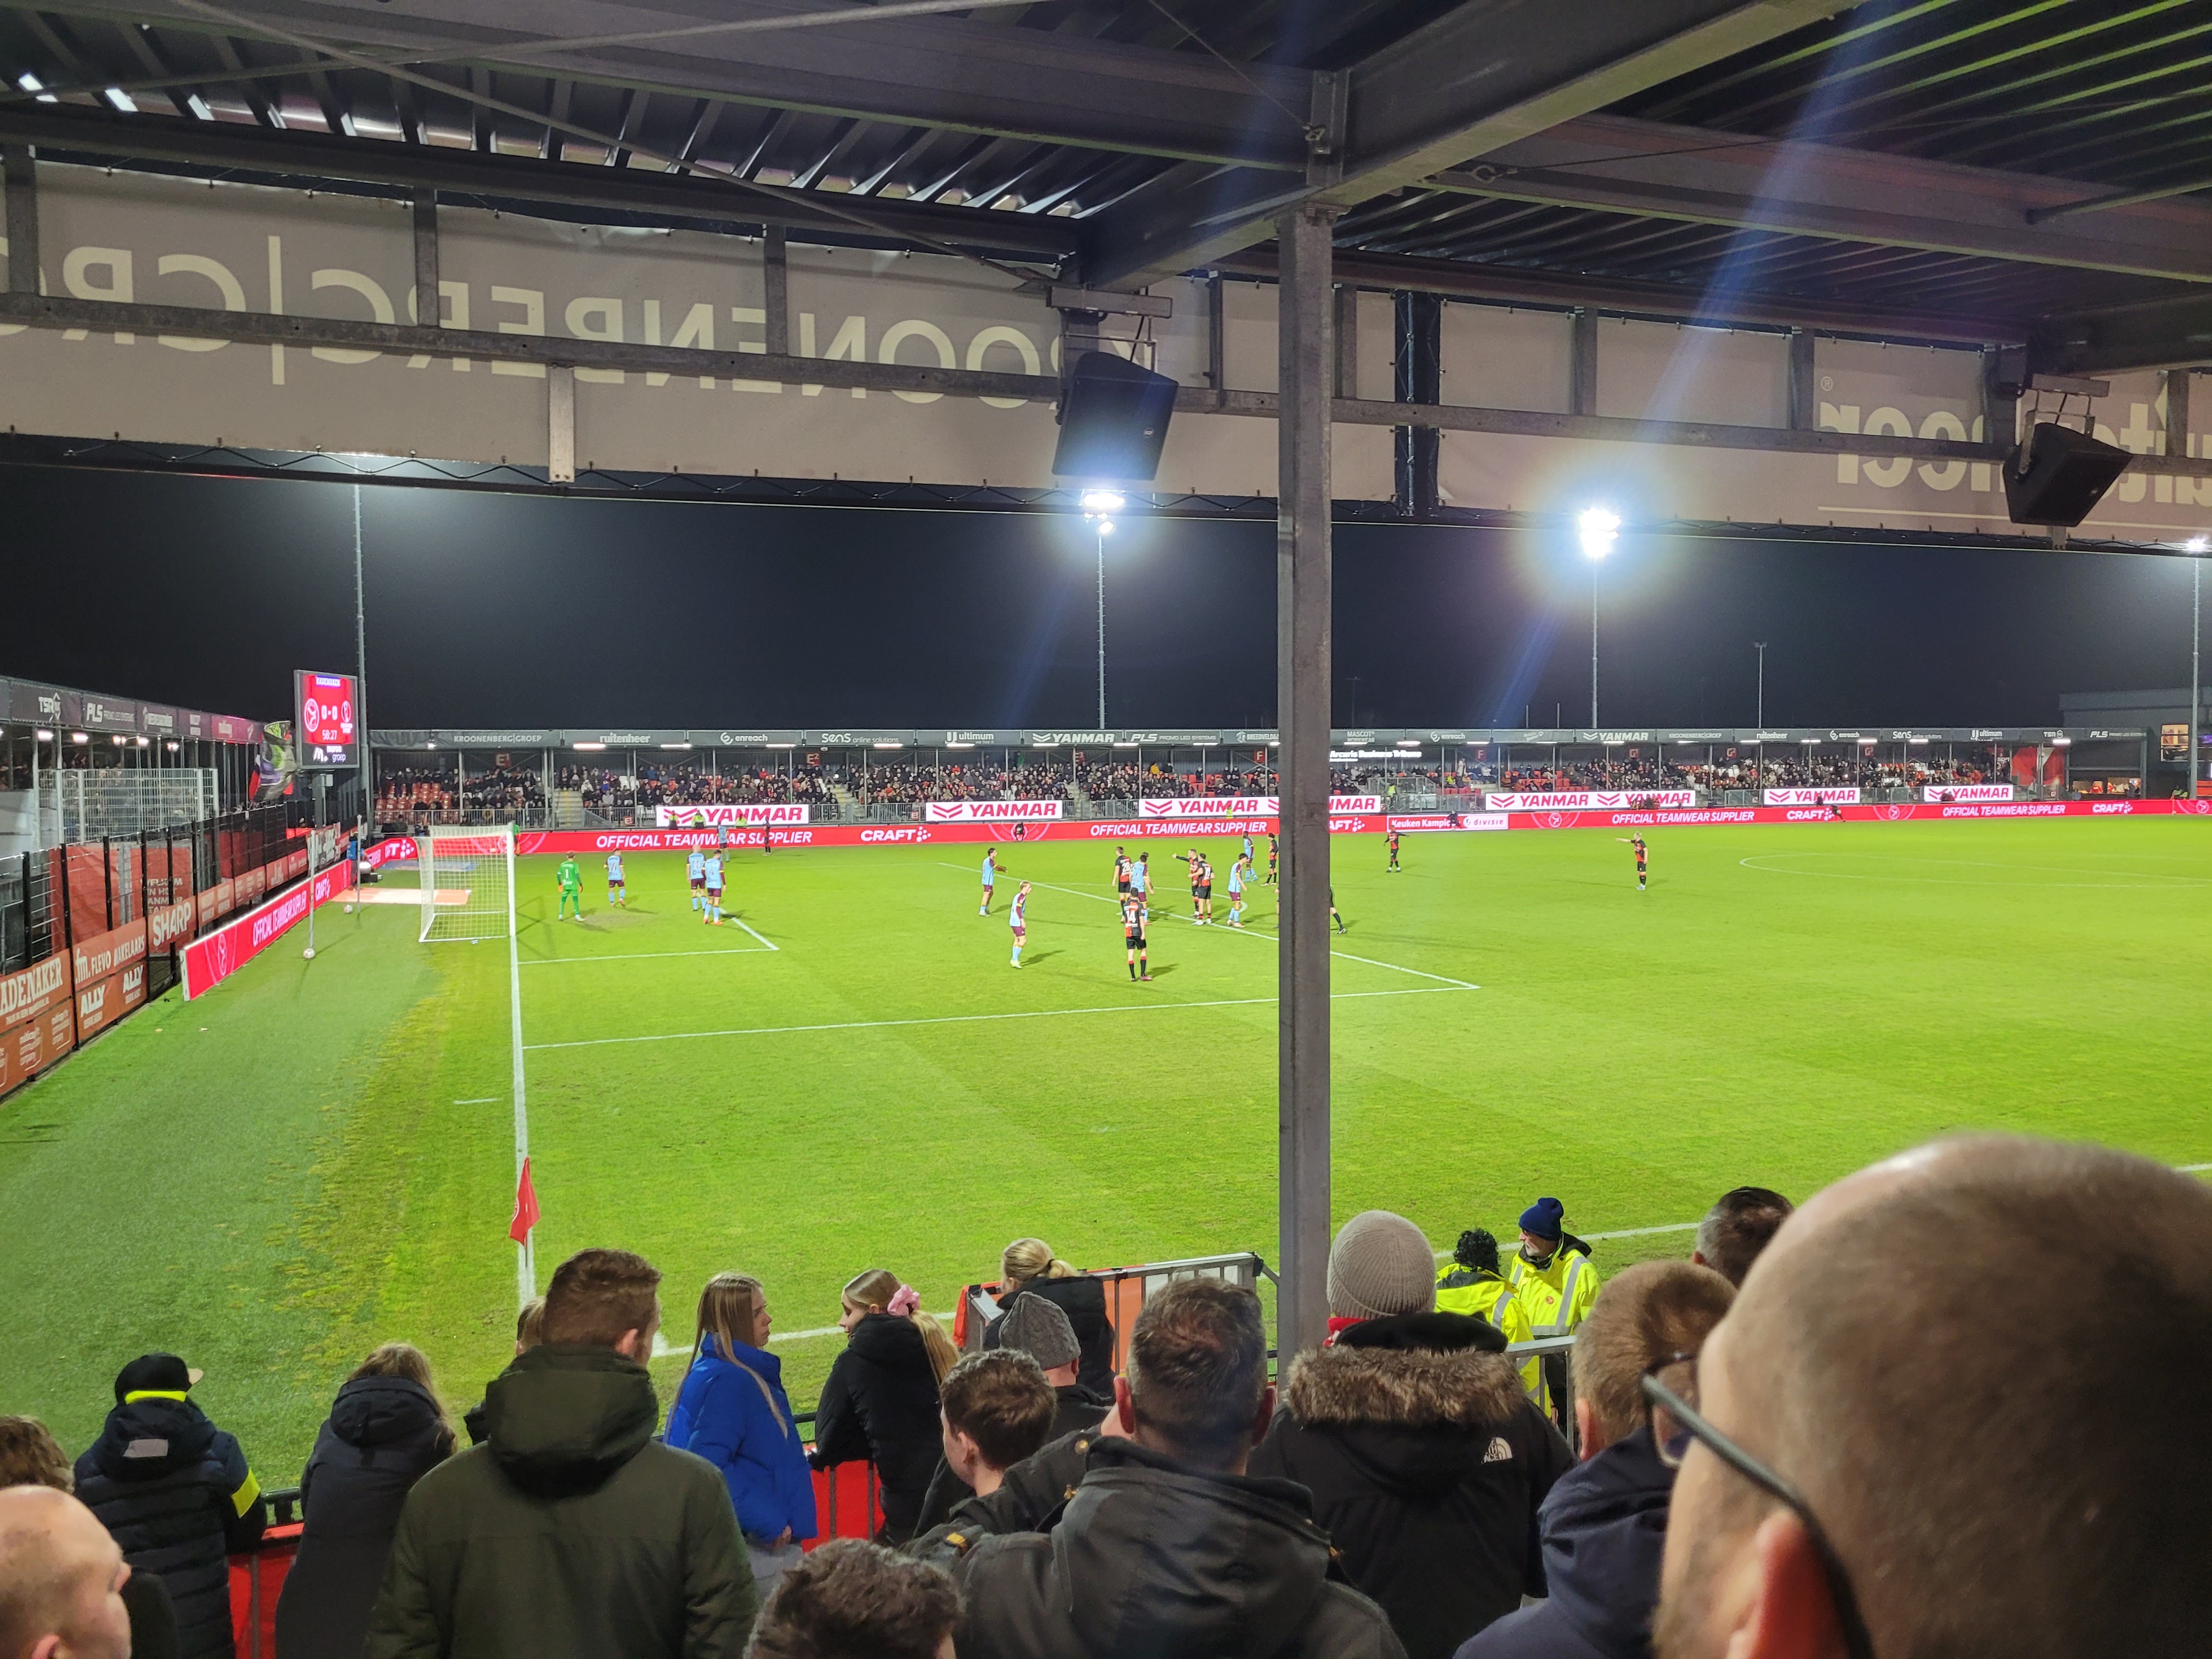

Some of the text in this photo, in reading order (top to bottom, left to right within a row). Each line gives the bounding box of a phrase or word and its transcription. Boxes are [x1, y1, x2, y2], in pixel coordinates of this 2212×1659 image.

[599, 732, 651, 743] ruitenheer
[958, 732, 994, 741] ultimum
[1052, 733, 1115, 743] YANMAR
[1130, 733, 1158, 742] PLS
[1599, 732, 1649, 741] YANMAR
[332, 754, 347, 762] groep
[1256, 751, 1263, 760] F
[1478, 750, 1483, 759] F
[1953, 788, 2009, 799] YANMAR
[1330, 798, 1375, 810] MAR
[1520, 794, 1589, 806] YANMAR
[969, 803, 1056, 817] YANMAR
[1178, 800, 1258, 813] YANMAR
[1942, 804, 2066, 816] OFFICIAL TEAMWEAR SUPPLIER
[2092, 804, 2124, 813] CRAFT
[705, 807, 802, 822] YANMAR
[1612, 811, 1755, 824] OFFICIAL TEAMWEAR SUPPLIER
[1786, 809, 1824, 820] CRAFT
[1090, 821, 1267, 836] OFFICIAL TEAMWEAR SUPPLIER
[1391, 818, 1422, 828] Keuken
[596, 835, 661, 848] OFFICIAL
[664, 832, 746, 847] TEAMWAR
[860, 829, 916, 842] CRAFT
[1125, 910, 1137, 923] 14
[153, 901, 191, 946] SHARP
[92, 950, 111, 973] FLEVO
[114, 934, 144, 967] MAKELAARS
[123, 964, 144, 994] ALLY
[81, 984, 105, 1018] ALLY
